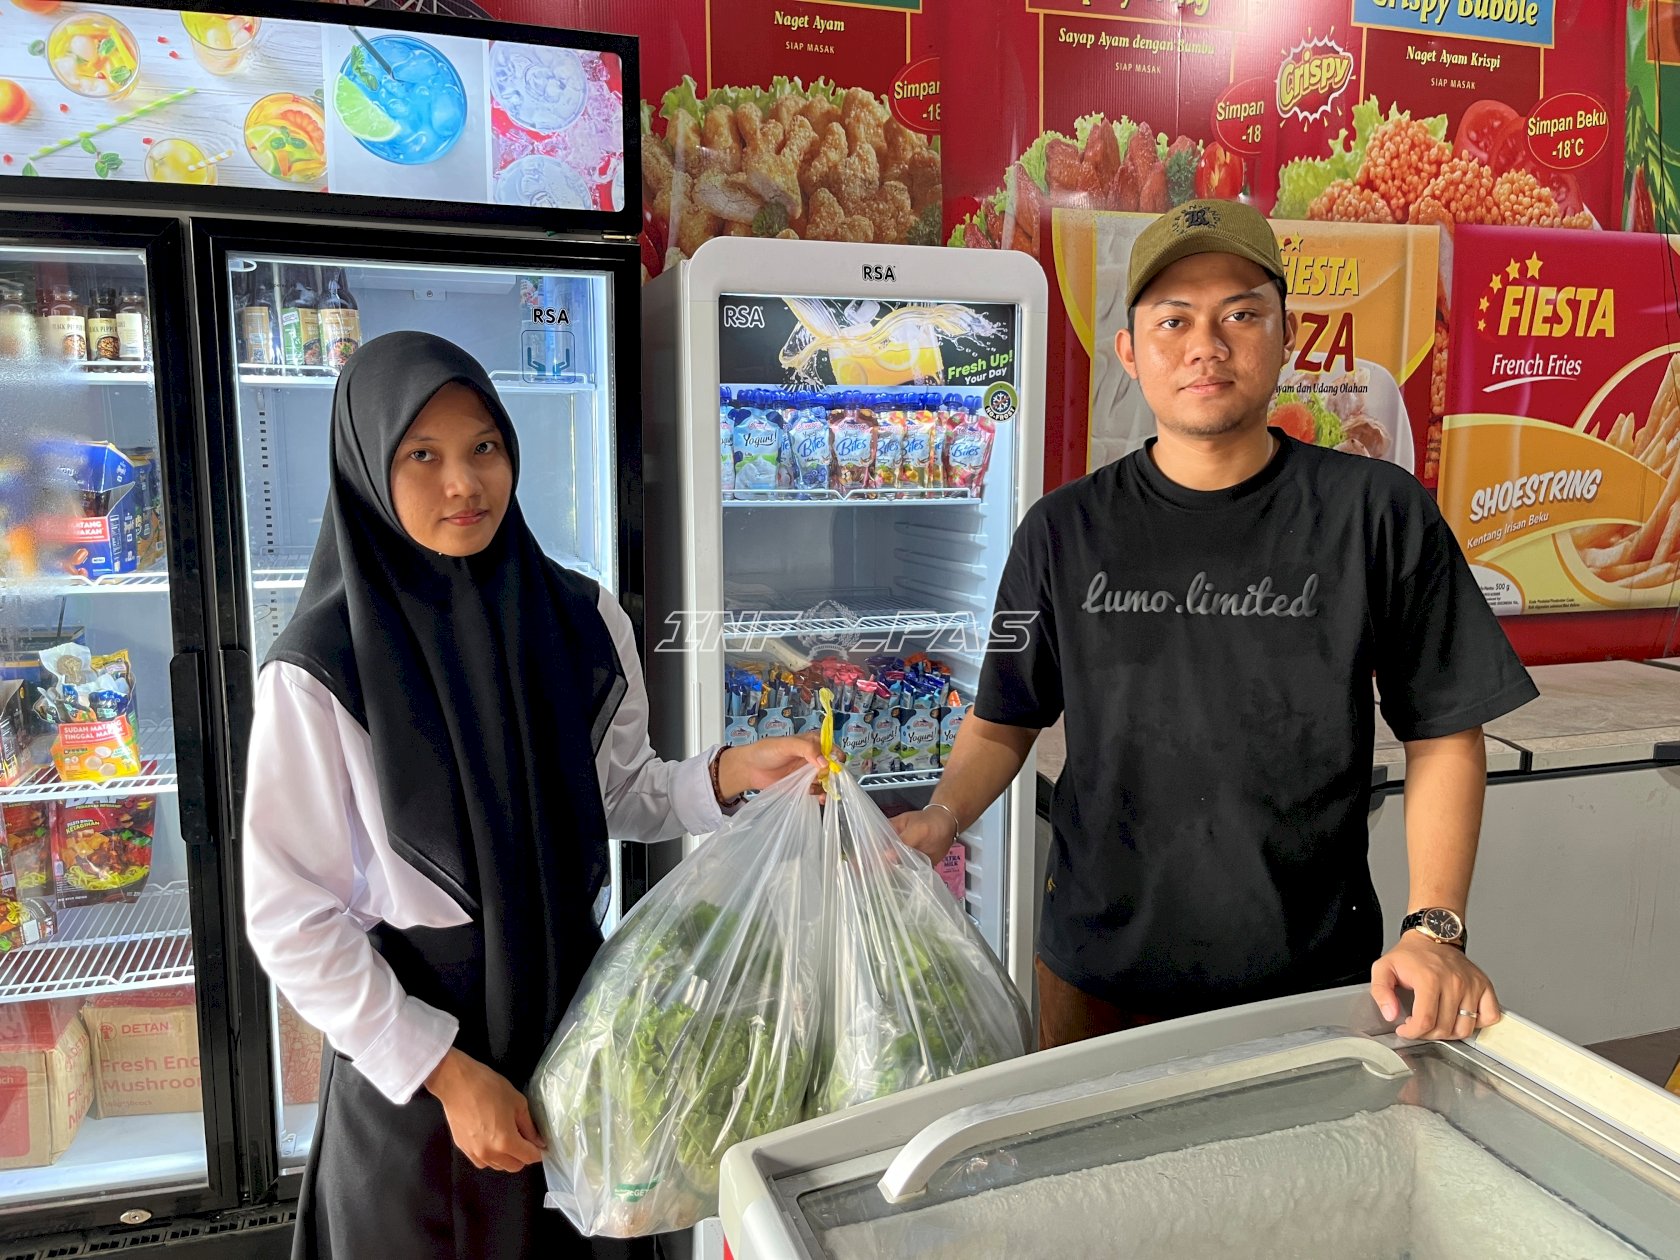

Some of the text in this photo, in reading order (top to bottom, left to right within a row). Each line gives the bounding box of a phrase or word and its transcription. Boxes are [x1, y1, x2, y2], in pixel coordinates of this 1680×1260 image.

[774, 11, 845, 33] Naget Ayam
[1373, 0, 1447, 24] spy
[785, 41, 835, 54] SIAP MASAK
[1059, 28, 1094, 48] Sayap
[1098, 32, 1130, 50] Ayam
[1133, 34, 1174, 54] dengan
[1115, 62, 1161, 74] SIAP MASAK
[1406, 46, 1501, 71] Naget Ayam Krispi
[1280, 50, 1350, 108] Crispy
[1431, 78, 1476, 90] SIAP MASAK
[1216, 100, 1264, 122] Simpan
[1527, 109, 1607, 138] Simpan Beku
[1241, 125, 1262, 144] -18
[862, 264, 896, 282] RSA
[533, 308, 570, 324] RSA
[724, 305, 765, 329] RSA
[1497, 286, 1615, 338] FIESTA
[947, 349, 1013, 380] Fresh Up!
[1491, 353, 1582, 375] French Fries
[964, 367, 1007, 385] Your Day
[1296, 383, 1312, 393] dan
[1313, 383, 1338, 396] Udang
[1339, 383, 1368, 393] Olahan
[797, 437, 825, 457] Bites
[836, 438, 867, 456] Bites
[1470, 468, 1602, 521] SHOESTRING
[1467, 512, 1549, 549] Kentang Irisan Beku
[64, 719, 122, 734] SUDAH MATG
[64, 733, 95, 741] TINGGAL
[121, 1022, 169, 1034] DETAN
[101, 1057, 158, 1073] Fresh
